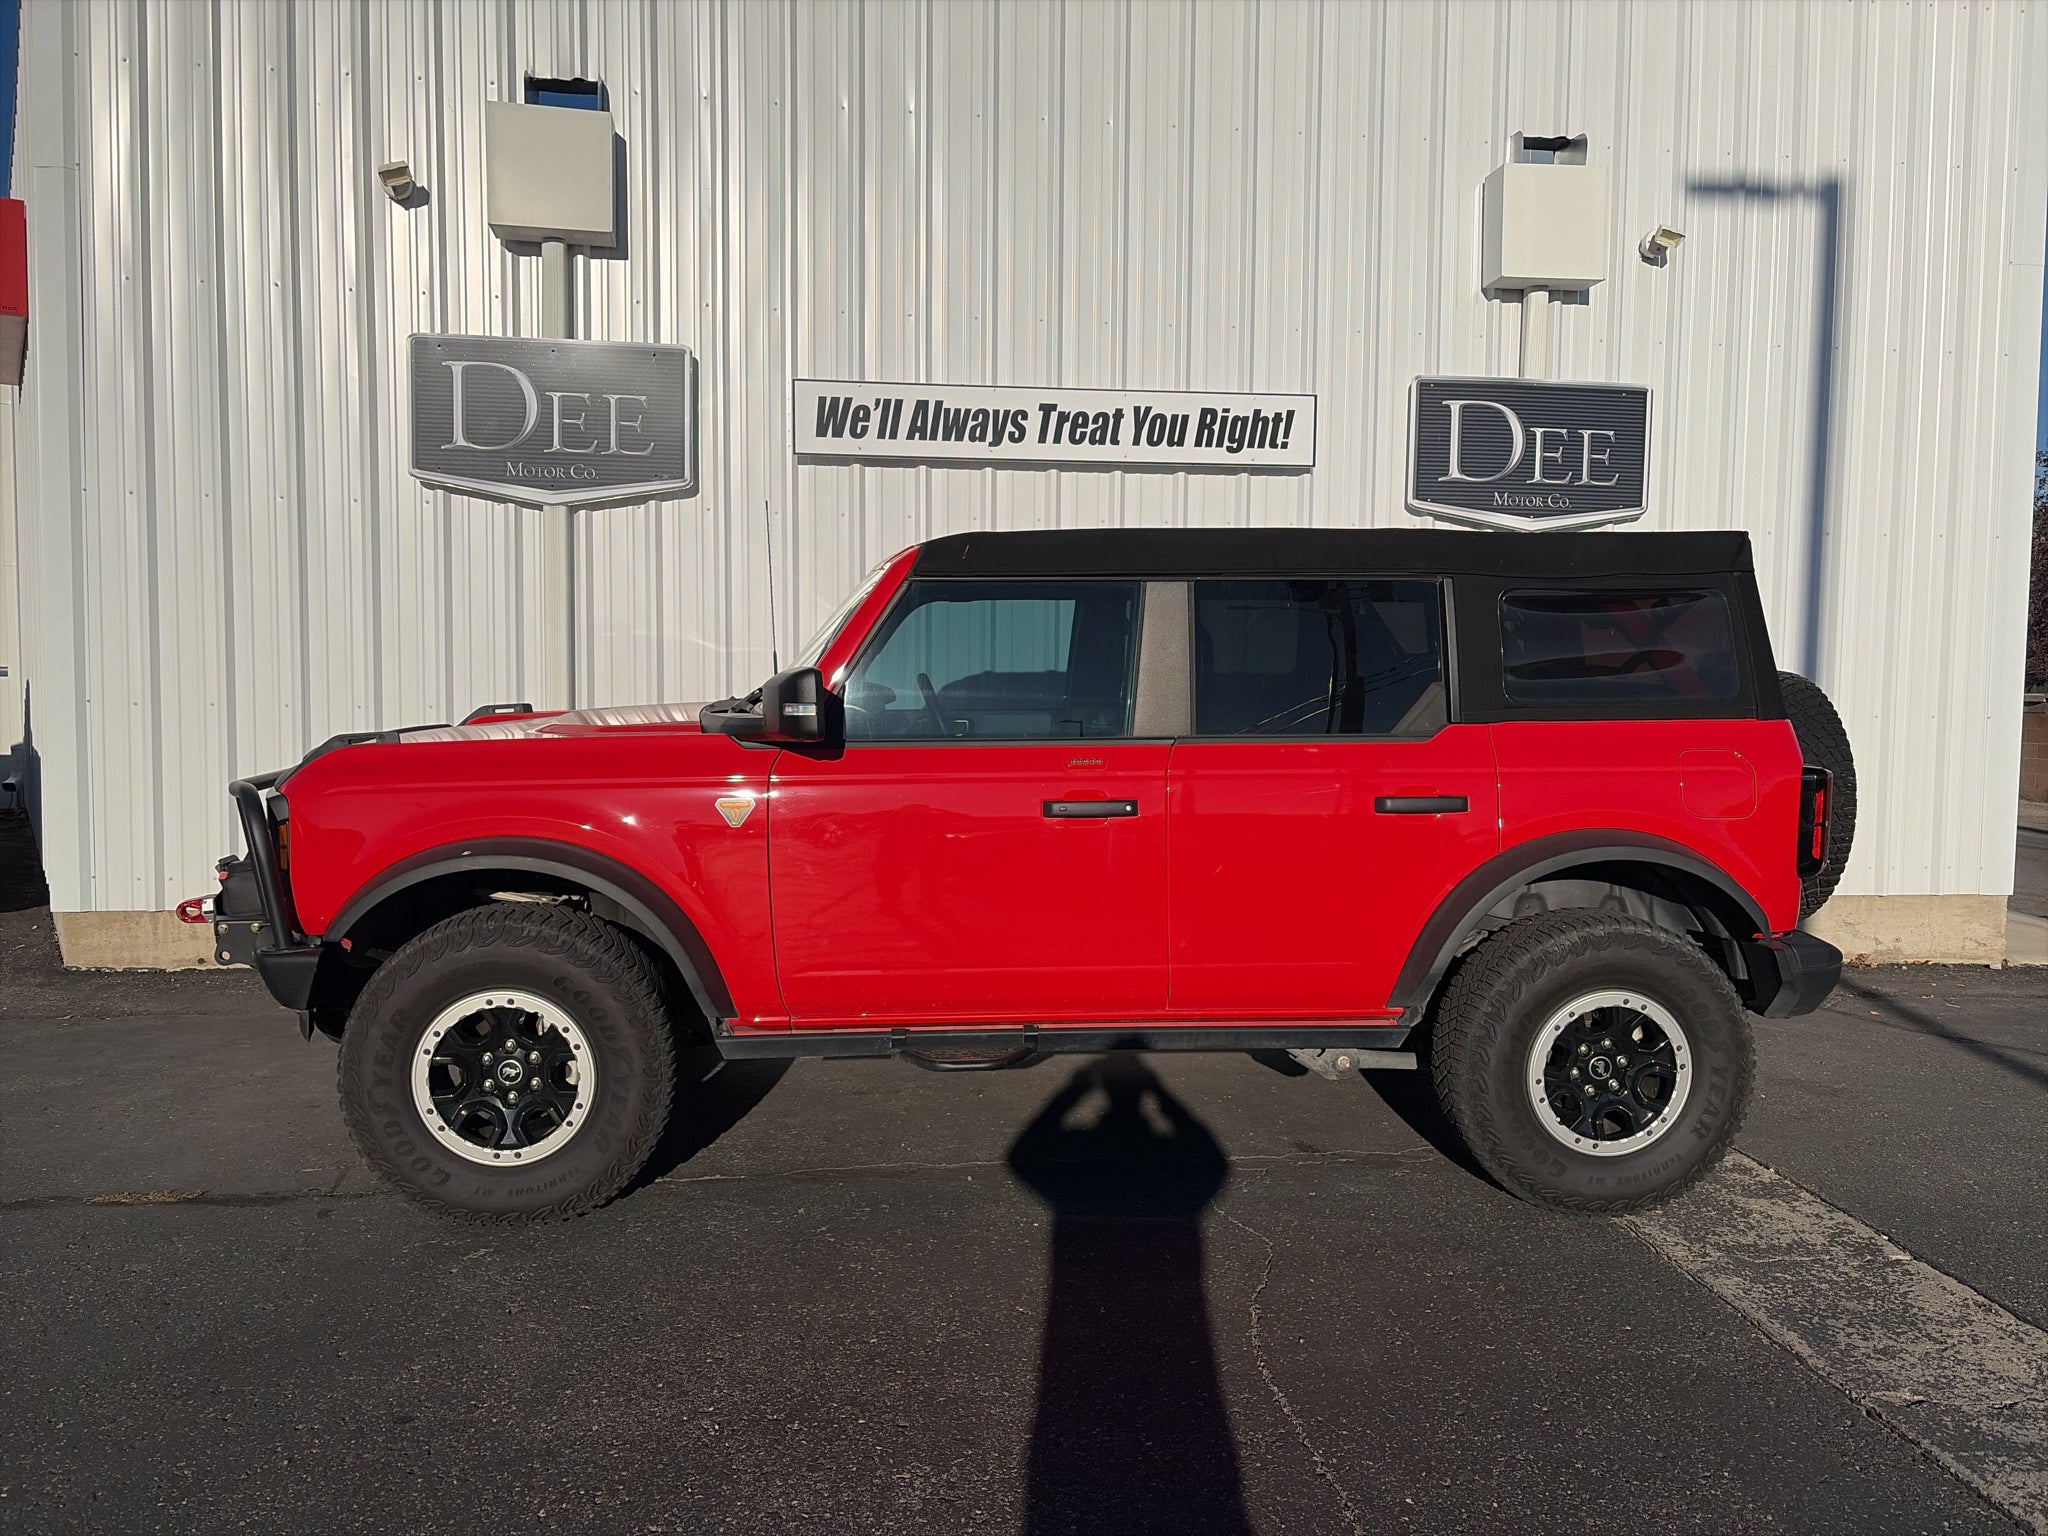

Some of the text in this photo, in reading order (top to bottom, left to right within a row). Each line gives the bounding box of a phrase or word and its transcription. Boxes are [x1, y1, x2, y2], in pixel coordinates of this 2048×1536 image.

[440, 360, 655, 456] DEE
[814, 395, 1297, 454] We'll Always Treat You Right!
[505, 461, 565, 480] MOTOR
[1437, 400, 1620, 487] DEE
[1493, 491, 1543, 508] MOTOR
